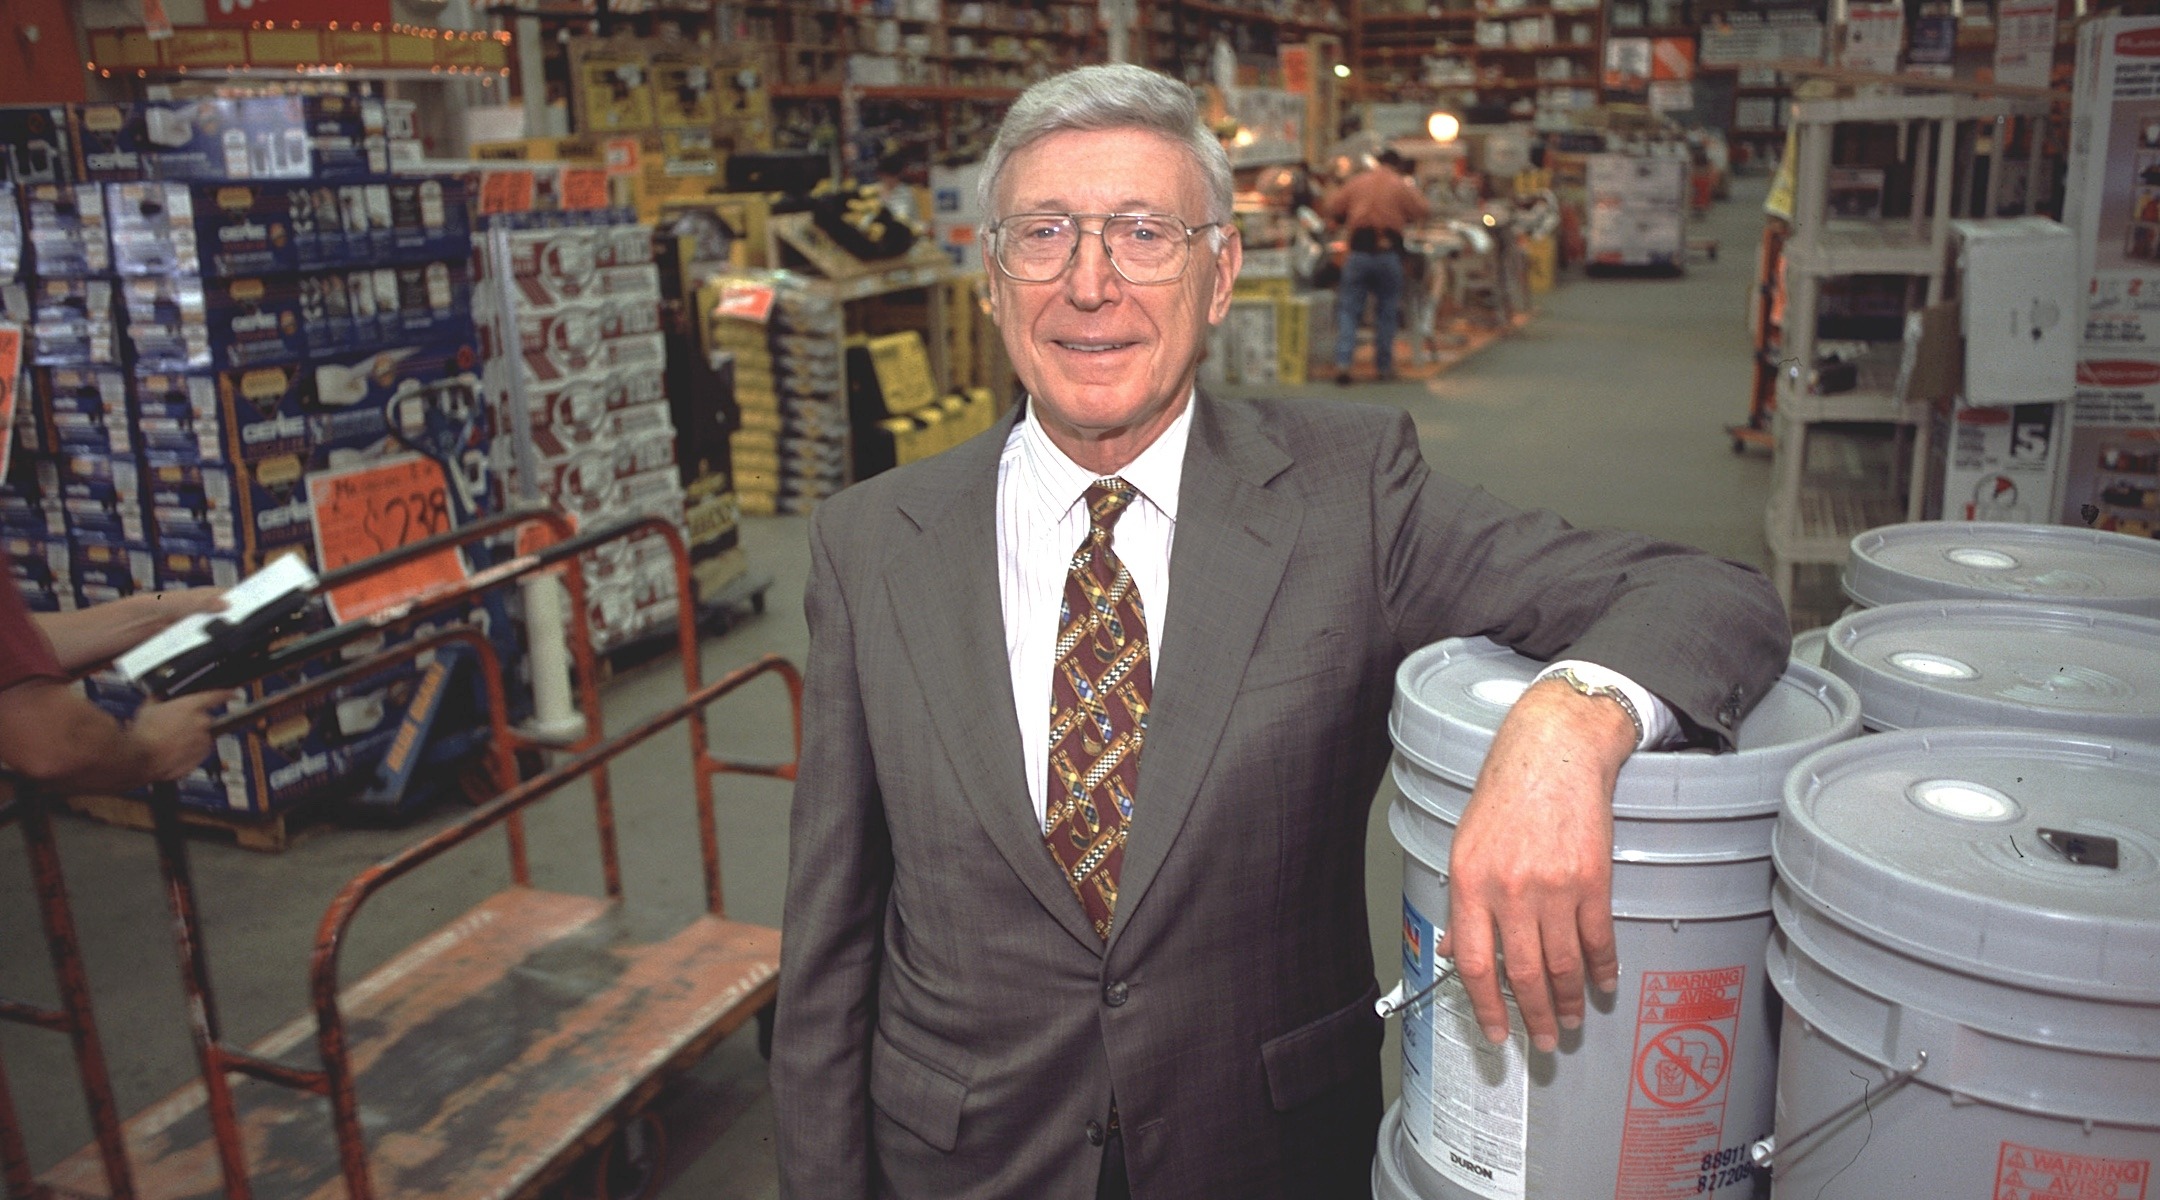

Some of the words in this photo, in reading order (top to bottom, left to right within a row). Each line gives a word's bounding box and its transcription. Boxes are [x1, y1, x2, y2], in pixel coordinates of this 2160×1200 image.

[2014, 423, 2048, 460] 5
[1665, 969, 1740, 989] WARNING
[1677, 986, 1726, 1004] AVISO
[1450, 1151, 1495, 1181] DURON
[2032, 1152, 2141, 1184] WARNING
[2049, 1175, 2120, 1198] AVISO
